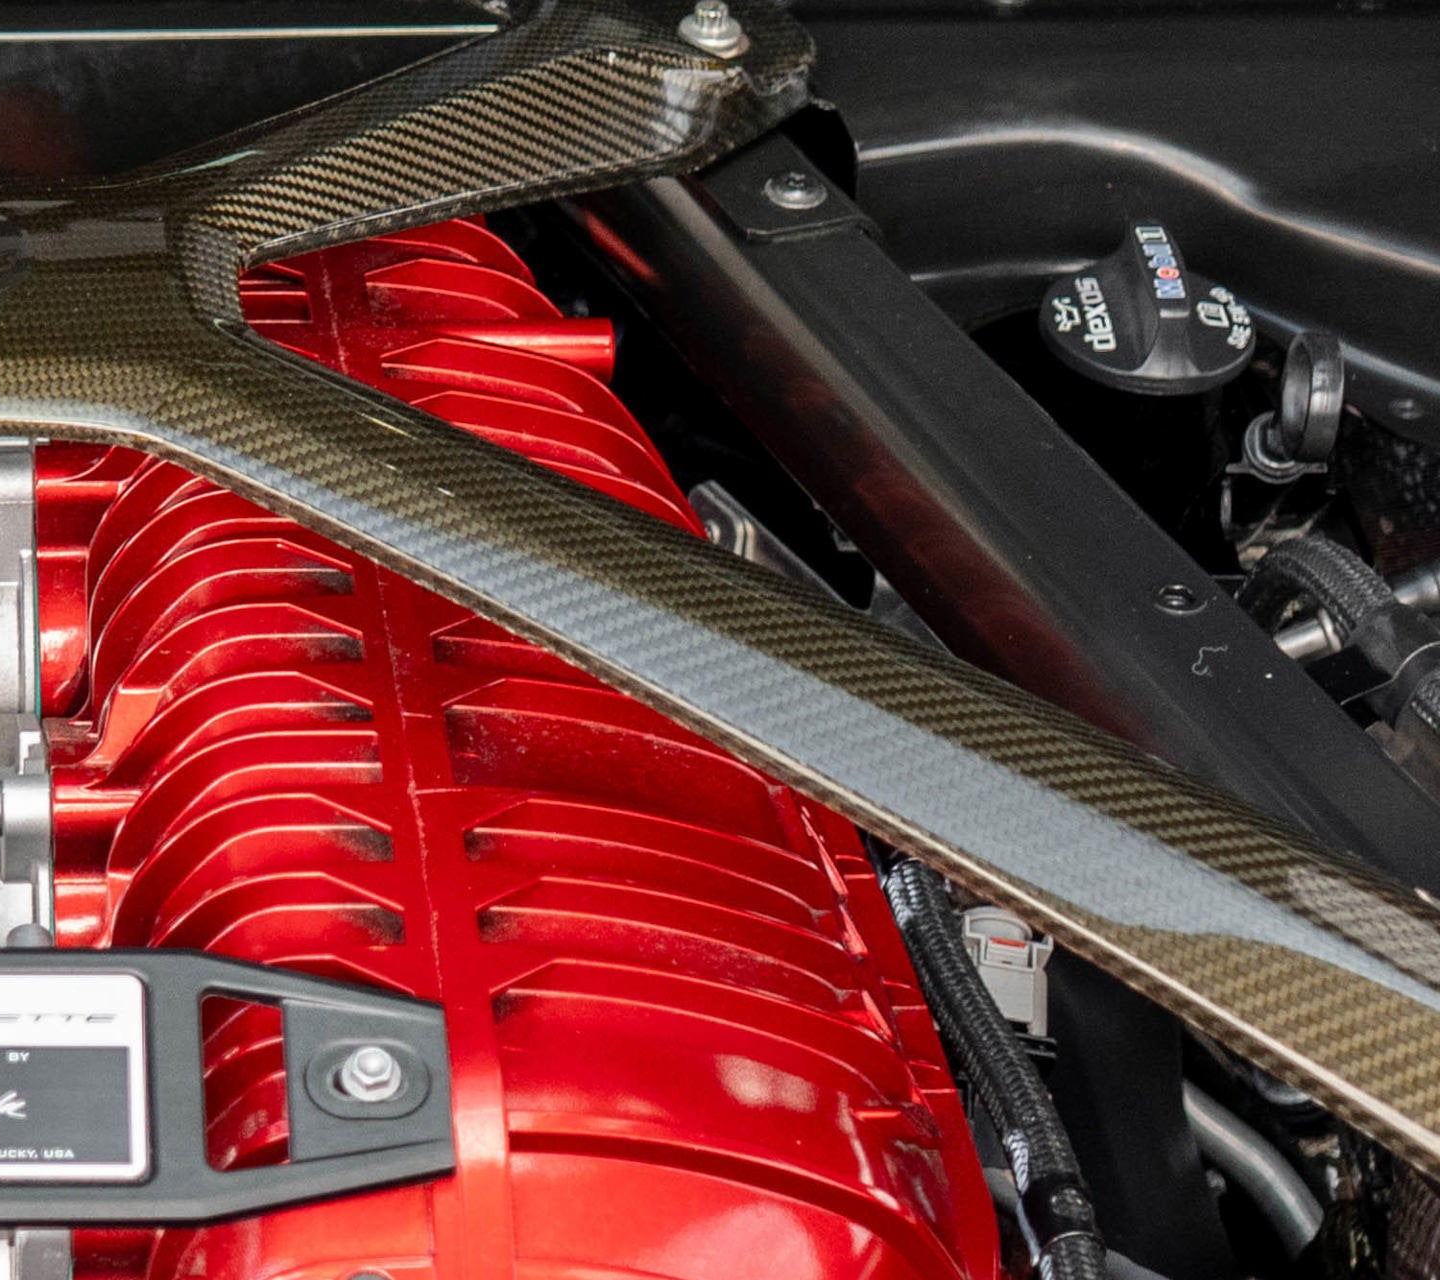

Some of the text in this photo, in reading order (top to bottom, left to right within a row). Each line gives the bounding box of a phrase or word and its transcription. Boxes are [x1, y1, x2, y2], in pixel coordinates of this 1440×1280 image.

[1142, 242, 1187, 299] Mobil
[1075, 276, 1118, 353] dexos
[7, 1050, 30, 1063] BY
[42, 1148, 75, 1160] USA
